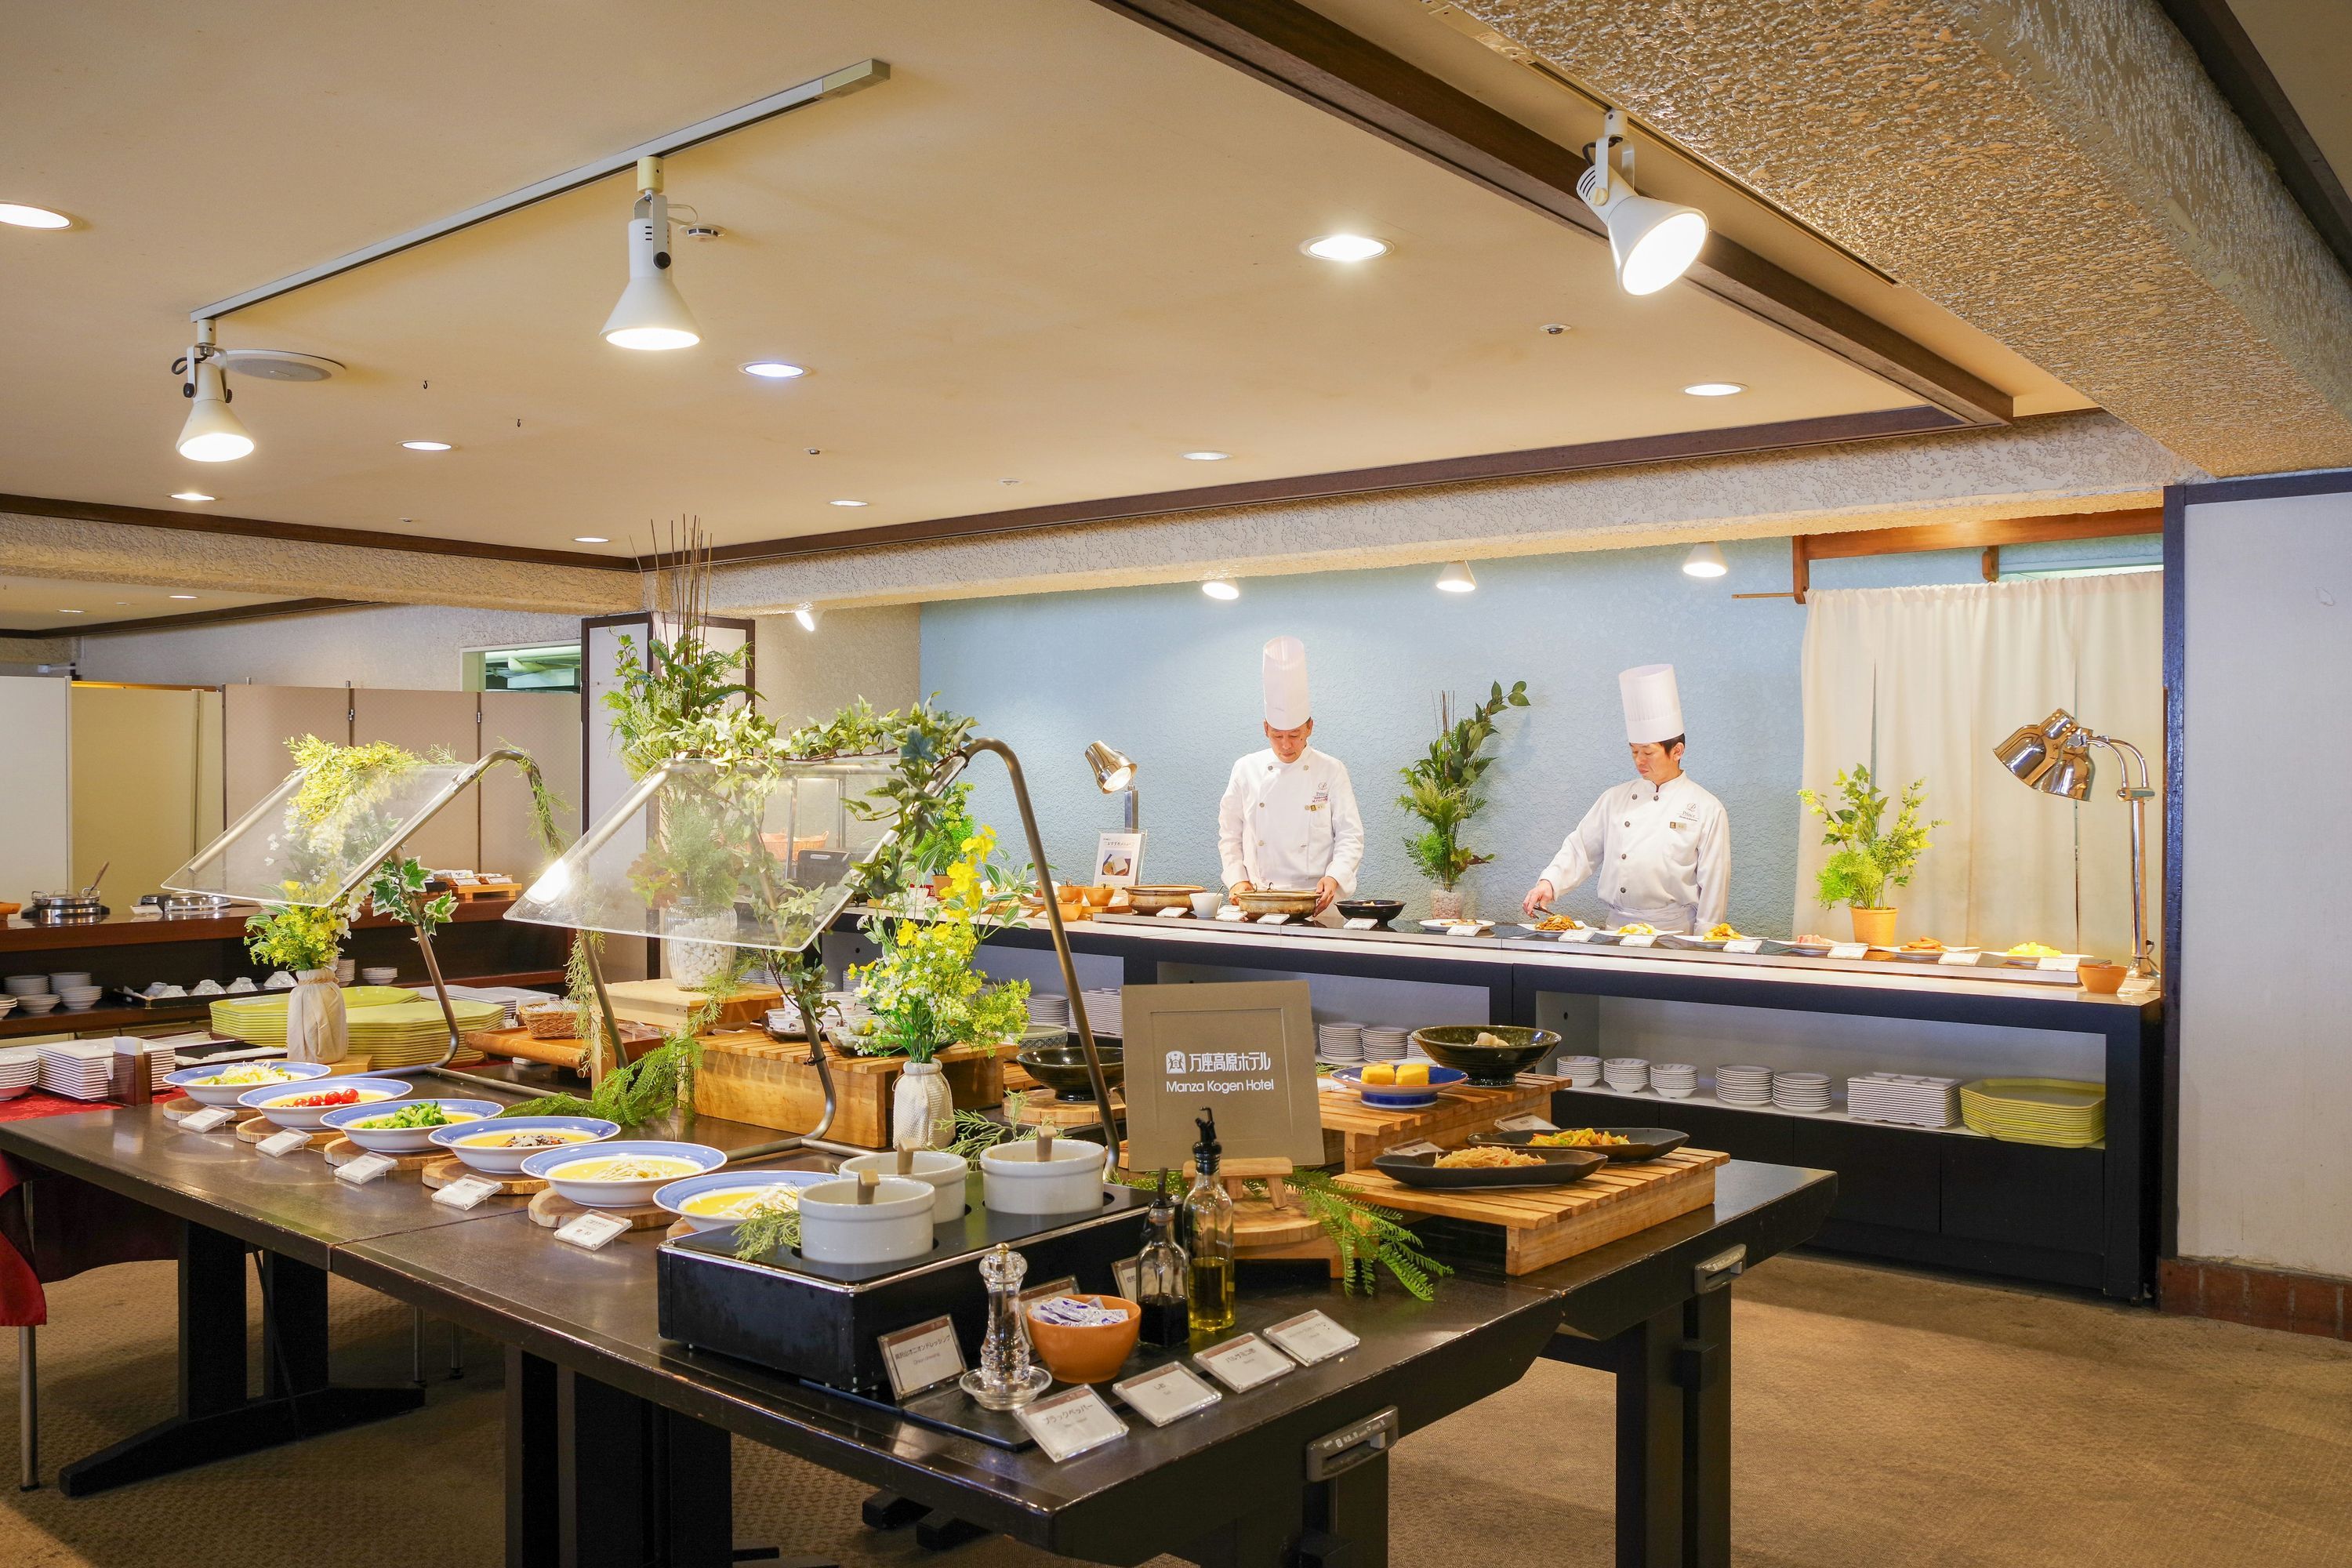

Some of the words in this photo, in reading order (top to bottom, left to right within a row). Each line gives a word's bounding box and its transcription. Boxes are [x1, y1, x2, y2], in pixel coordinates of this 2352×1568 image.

[1189, 1051, 1271, 1073] 万座高原ホテル
[1166, 1080, 1204, 1093] Manza
[1207, 1080, 1244, 1094] Kogen
[1246, 1078, 1274, 1091] Hotel
